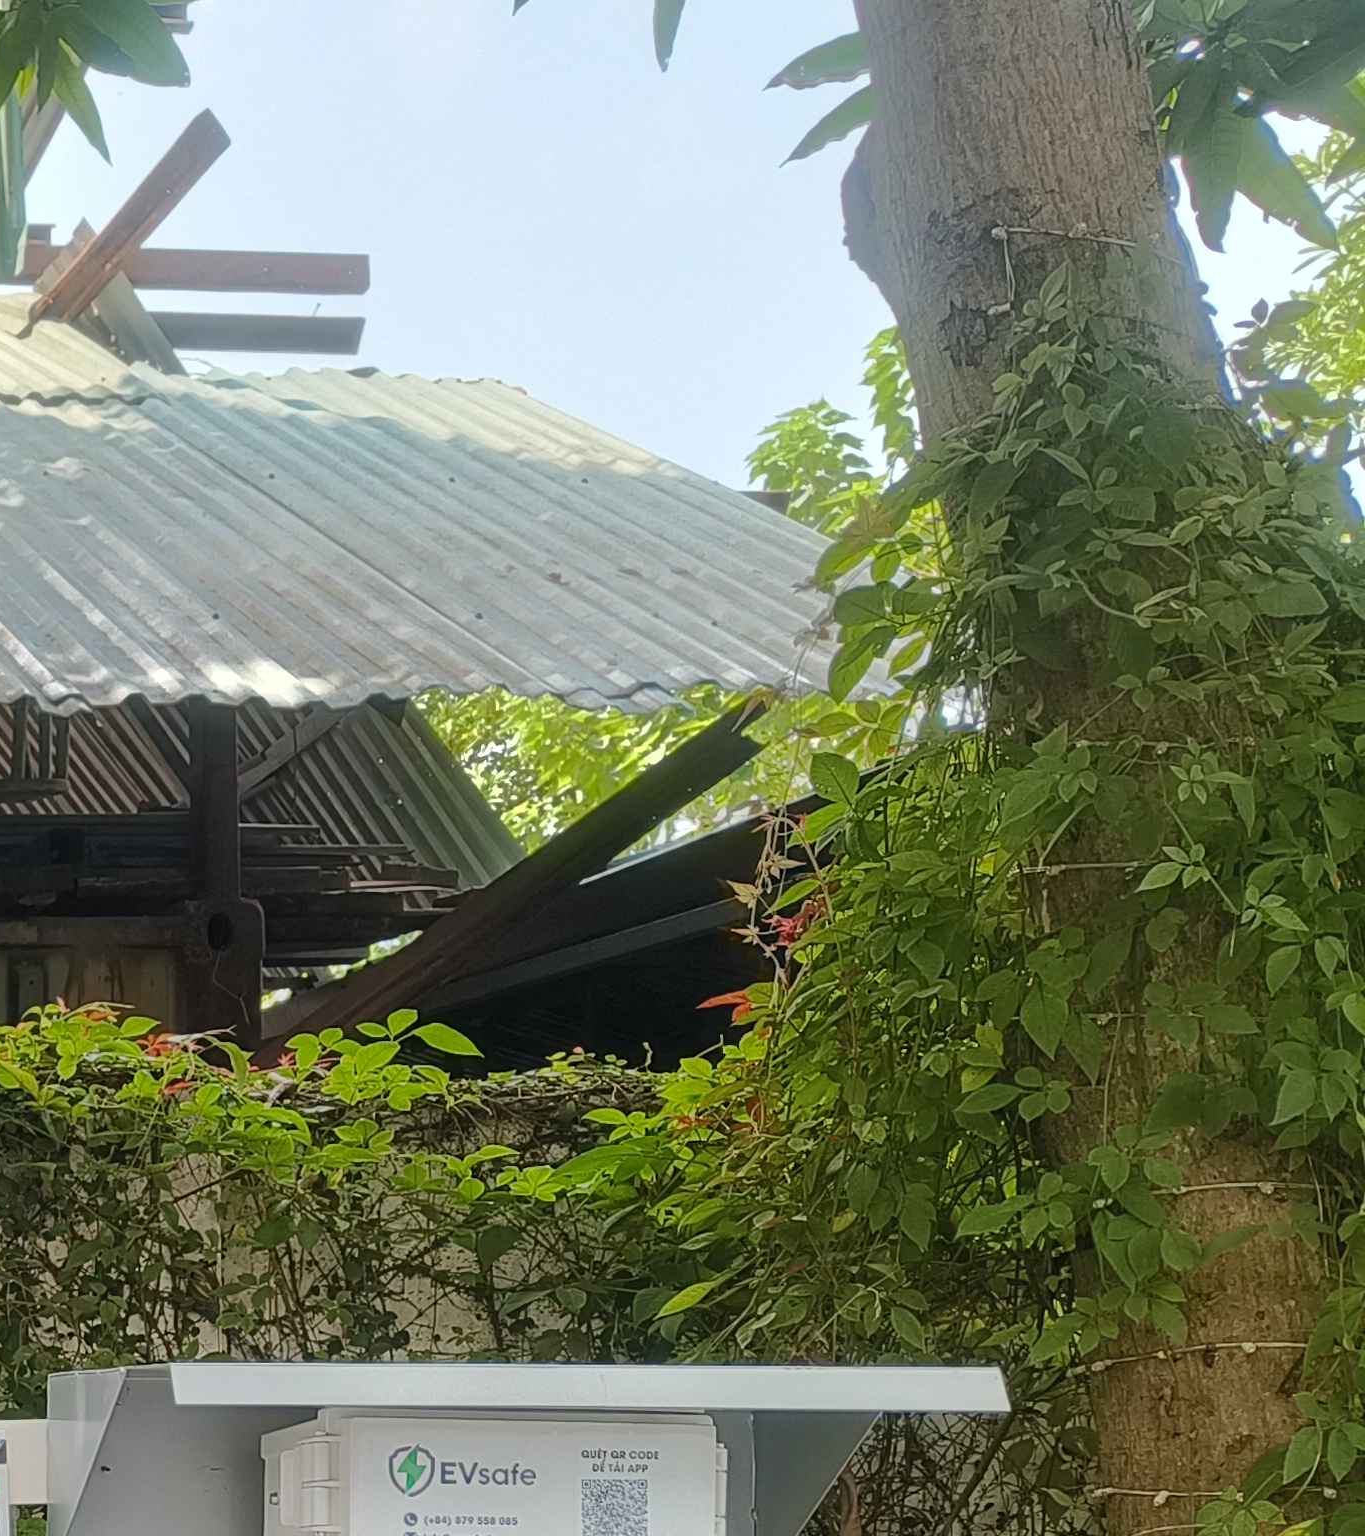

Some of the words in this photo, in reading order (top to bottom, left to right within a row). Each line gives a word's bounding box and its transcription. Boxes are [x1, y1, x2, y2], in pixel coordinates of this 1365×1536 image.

[611, 1450, 626, 1459] QR
[629, 1450, 659, 1460] CODE
[608, 1461, 624, 1472] TẢI
[627, 1463, 648, 1472] APP
[440, 1462, 536, 1486] EVsafe
[423, 1515, 452, 1526] (+84)
